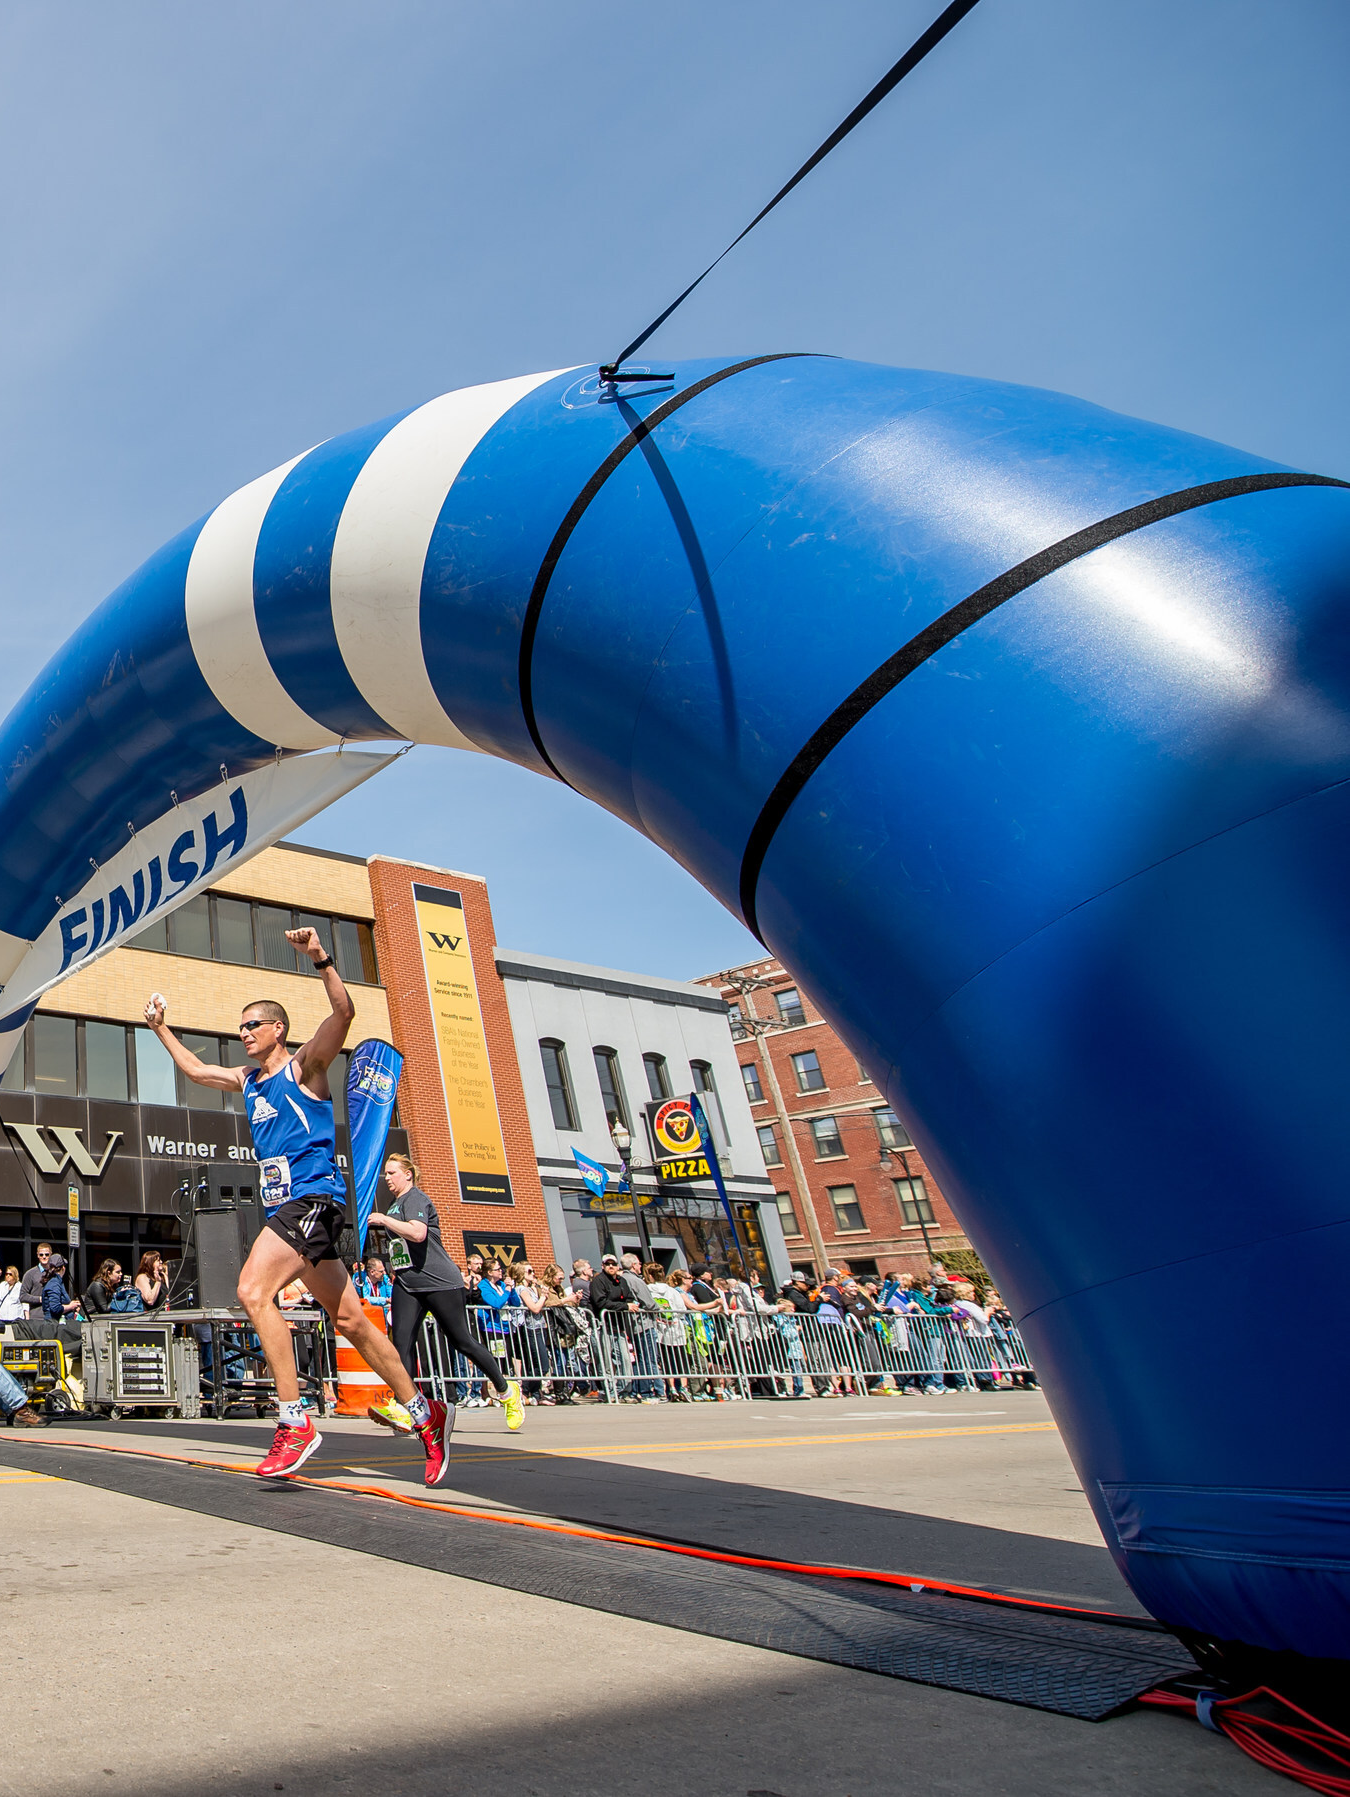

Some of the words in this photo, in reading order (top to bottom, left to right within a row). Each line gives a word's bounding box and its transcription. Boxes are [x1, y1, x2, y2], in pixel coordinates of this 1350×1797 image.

[56, 785, 249, 976] FINISH
[426, 930, 463, 951] W
[434, 987, 450, 996] Service
[441, 1011, 458, 1020] Recently
[457, 1028, 479, 1039] National
[442, 1036, 481, 1050] Family-Owned
[451, 1047, 476, 1059] Business
[451, 1059, 457, 1067] of
[458, 1060, 468, 1068] the
[468, 1061, 479, 1070] Year
[449, 1074, 459, 1084] The
[460, 1076, 489, 1088] Chamber's
[457, 1086, 483, 1098] Business
[457, 1098, 463, 1106] of
[464, 1099, 474, 1107] the
[475, 1100, 486, 1109] Year
[657, 1101, 678, 1121] SPICY
[3, 1122, 124, 1177] W
[147, 1134, 218, 1158] Warner
[462, 1141, 473, 1150] Our
[474, 1142, 490, 1152] Policy
[490, 1144, 496, 1152] is
[463, 1150, 486, 1161] Serving
[486, 1153, 497, 1161] You
[661, 1158, 711, 1179] PIZZA
